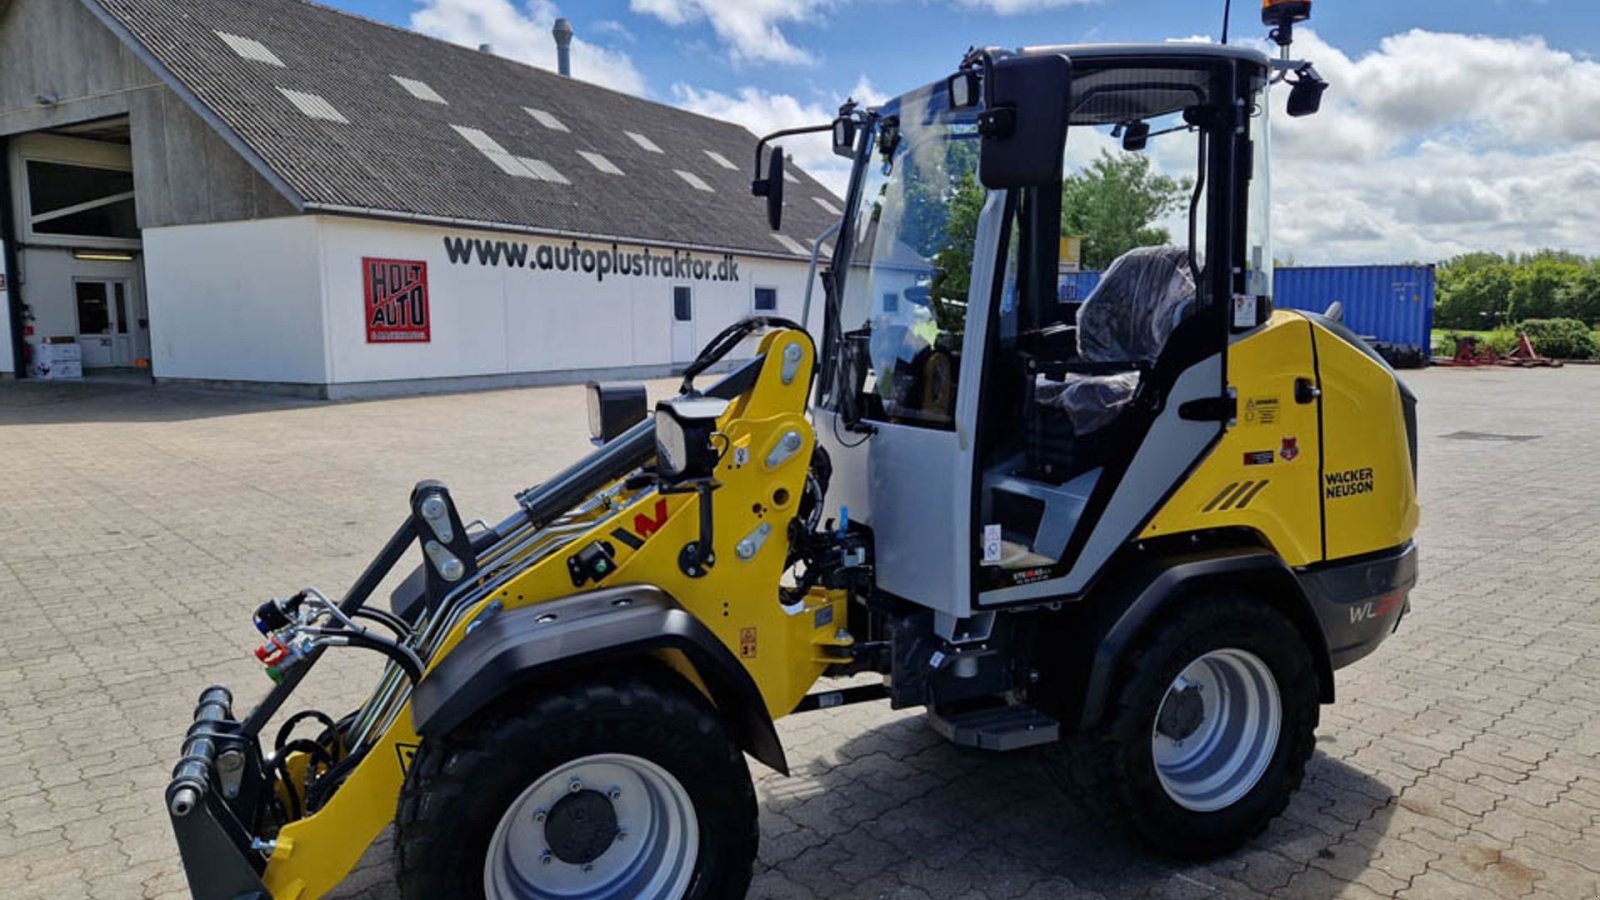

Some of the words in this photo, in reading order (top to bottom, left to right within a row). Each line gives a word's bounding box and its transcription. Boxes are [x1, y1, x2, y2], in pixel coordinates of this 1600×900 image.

[443, 236, 739, 281] www.autoplustraktor.dk
[370, 262, 421, 304] HOLT
[371, 285, 425, 326] AUTO
[1325, 467, 1374, 485] WACKER
[1326, 481, 1374, 499] NEUSON
